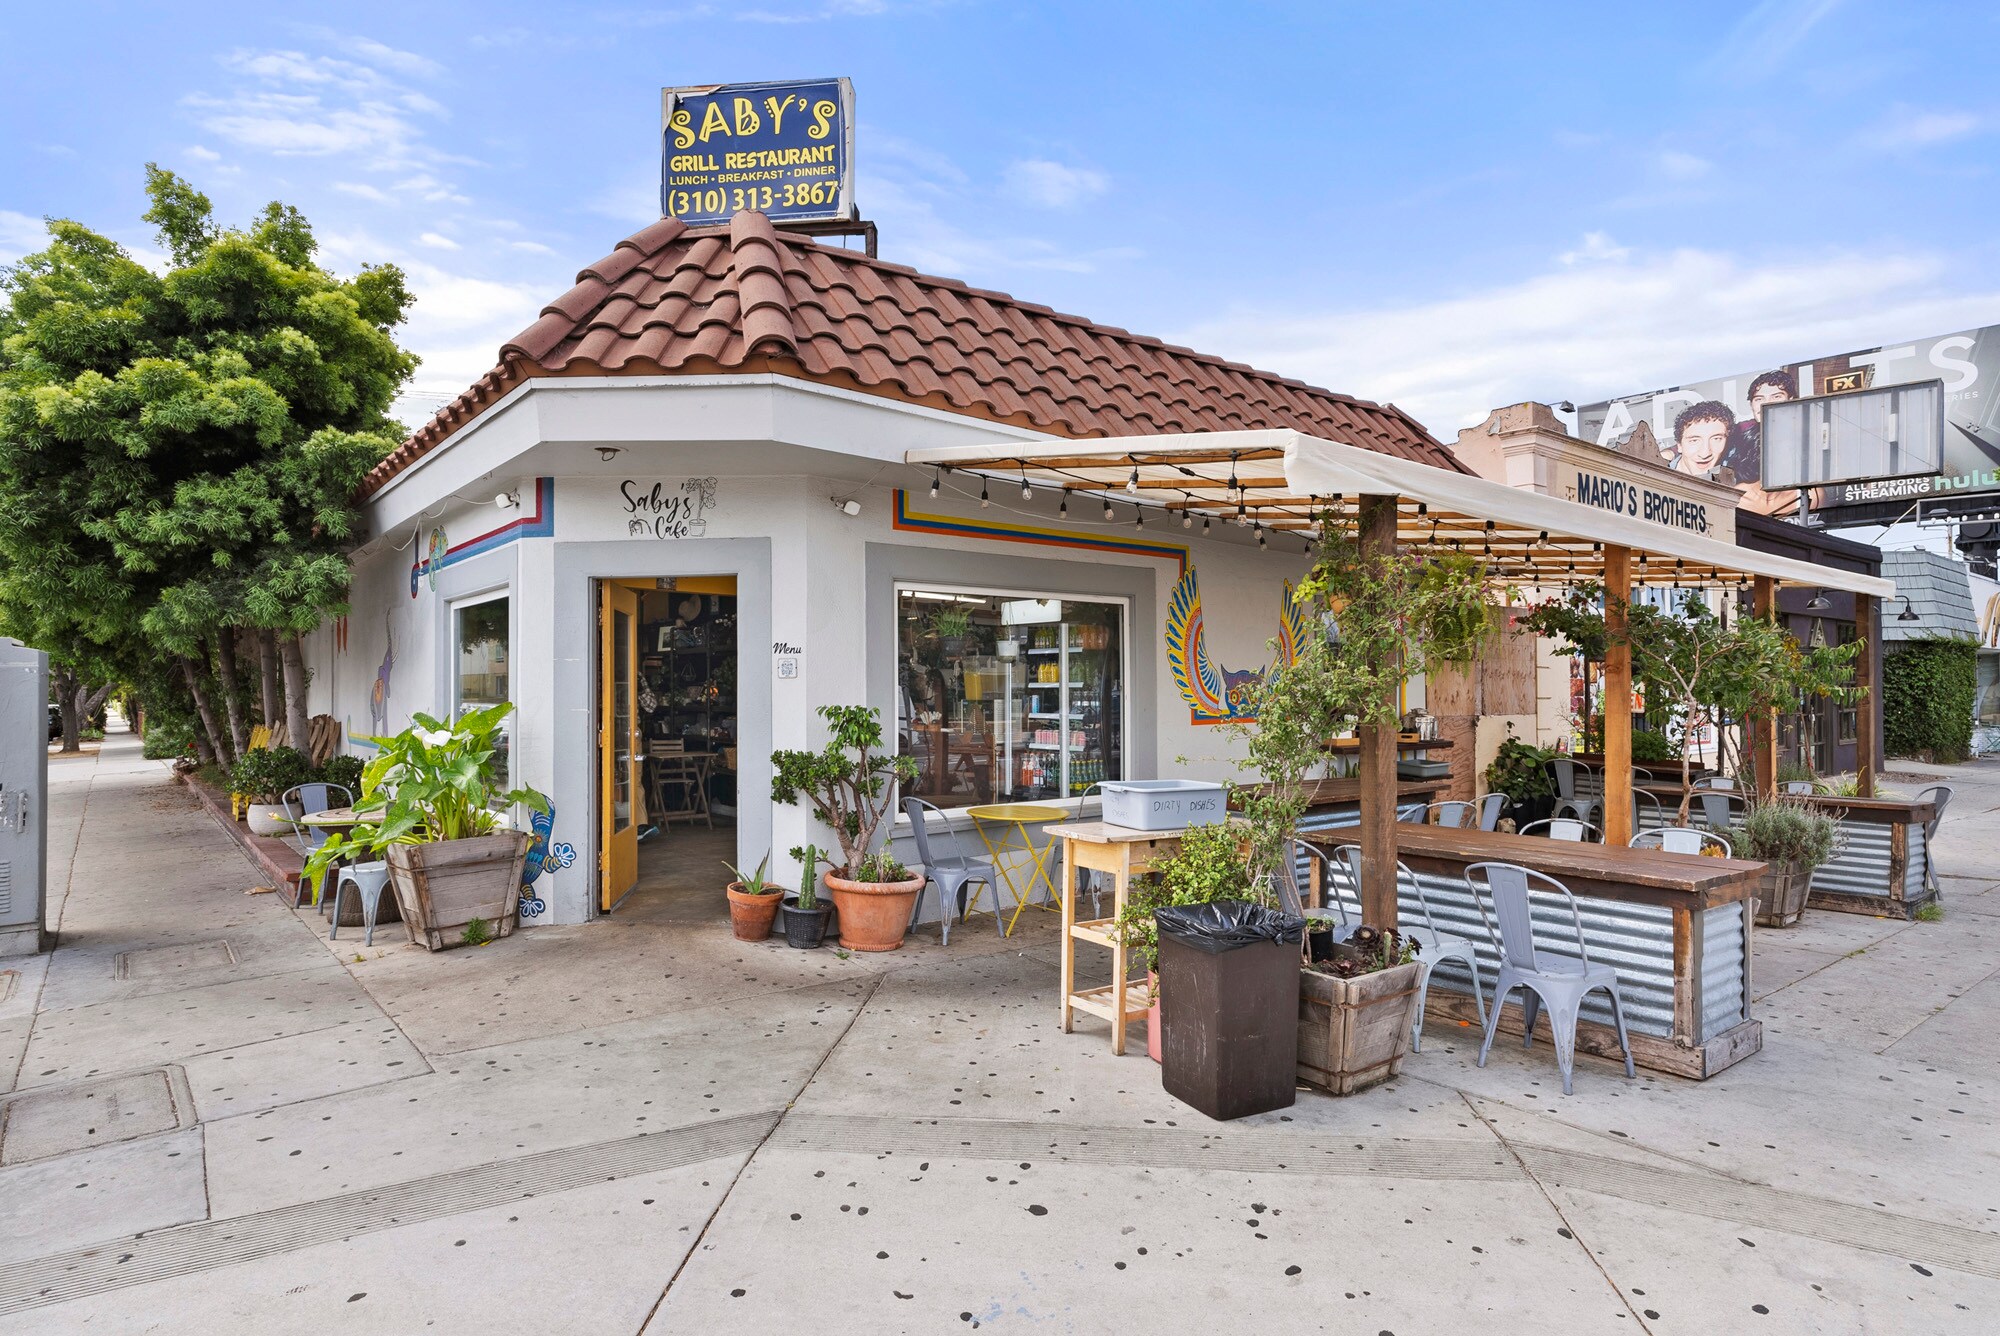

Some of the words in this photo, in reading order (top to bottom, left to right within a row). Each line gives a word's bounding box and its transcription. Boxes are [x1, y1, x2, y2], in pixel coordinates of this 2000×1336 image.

[669, 94, 837, 149] SABY'S
[670, 154, 719, 172] GRILL
[725, 144, 836, 169] RESTAURANT
[669, 175, 708, 186] LUNCH
[717, 169, 785, 184] BREAKFAST
[793, 165, 836, 177] DINNER
[668, 187, 727, 217] (310)
[732, 180, 839, 211] 313-3867
[1832, 376, 1857, 392] FX
[1845, 483, 1868, 492] ALL
[1871, 477, 1930, 489] EPISODES
[1845, 482, 1931, 501] STREAMING
[620, 479, 695, 523] Saby's
[1577, 472, 1638, 516] MARIO'S
[1643, 490, 1707, 533] BROTHERS
[655, 516, 689, 539] Cafe
[772, 642, 802, 654] Menu
[1153, 800, 1181, 814] DIRTY
[1189, 798, 1216, 811] DISHES
